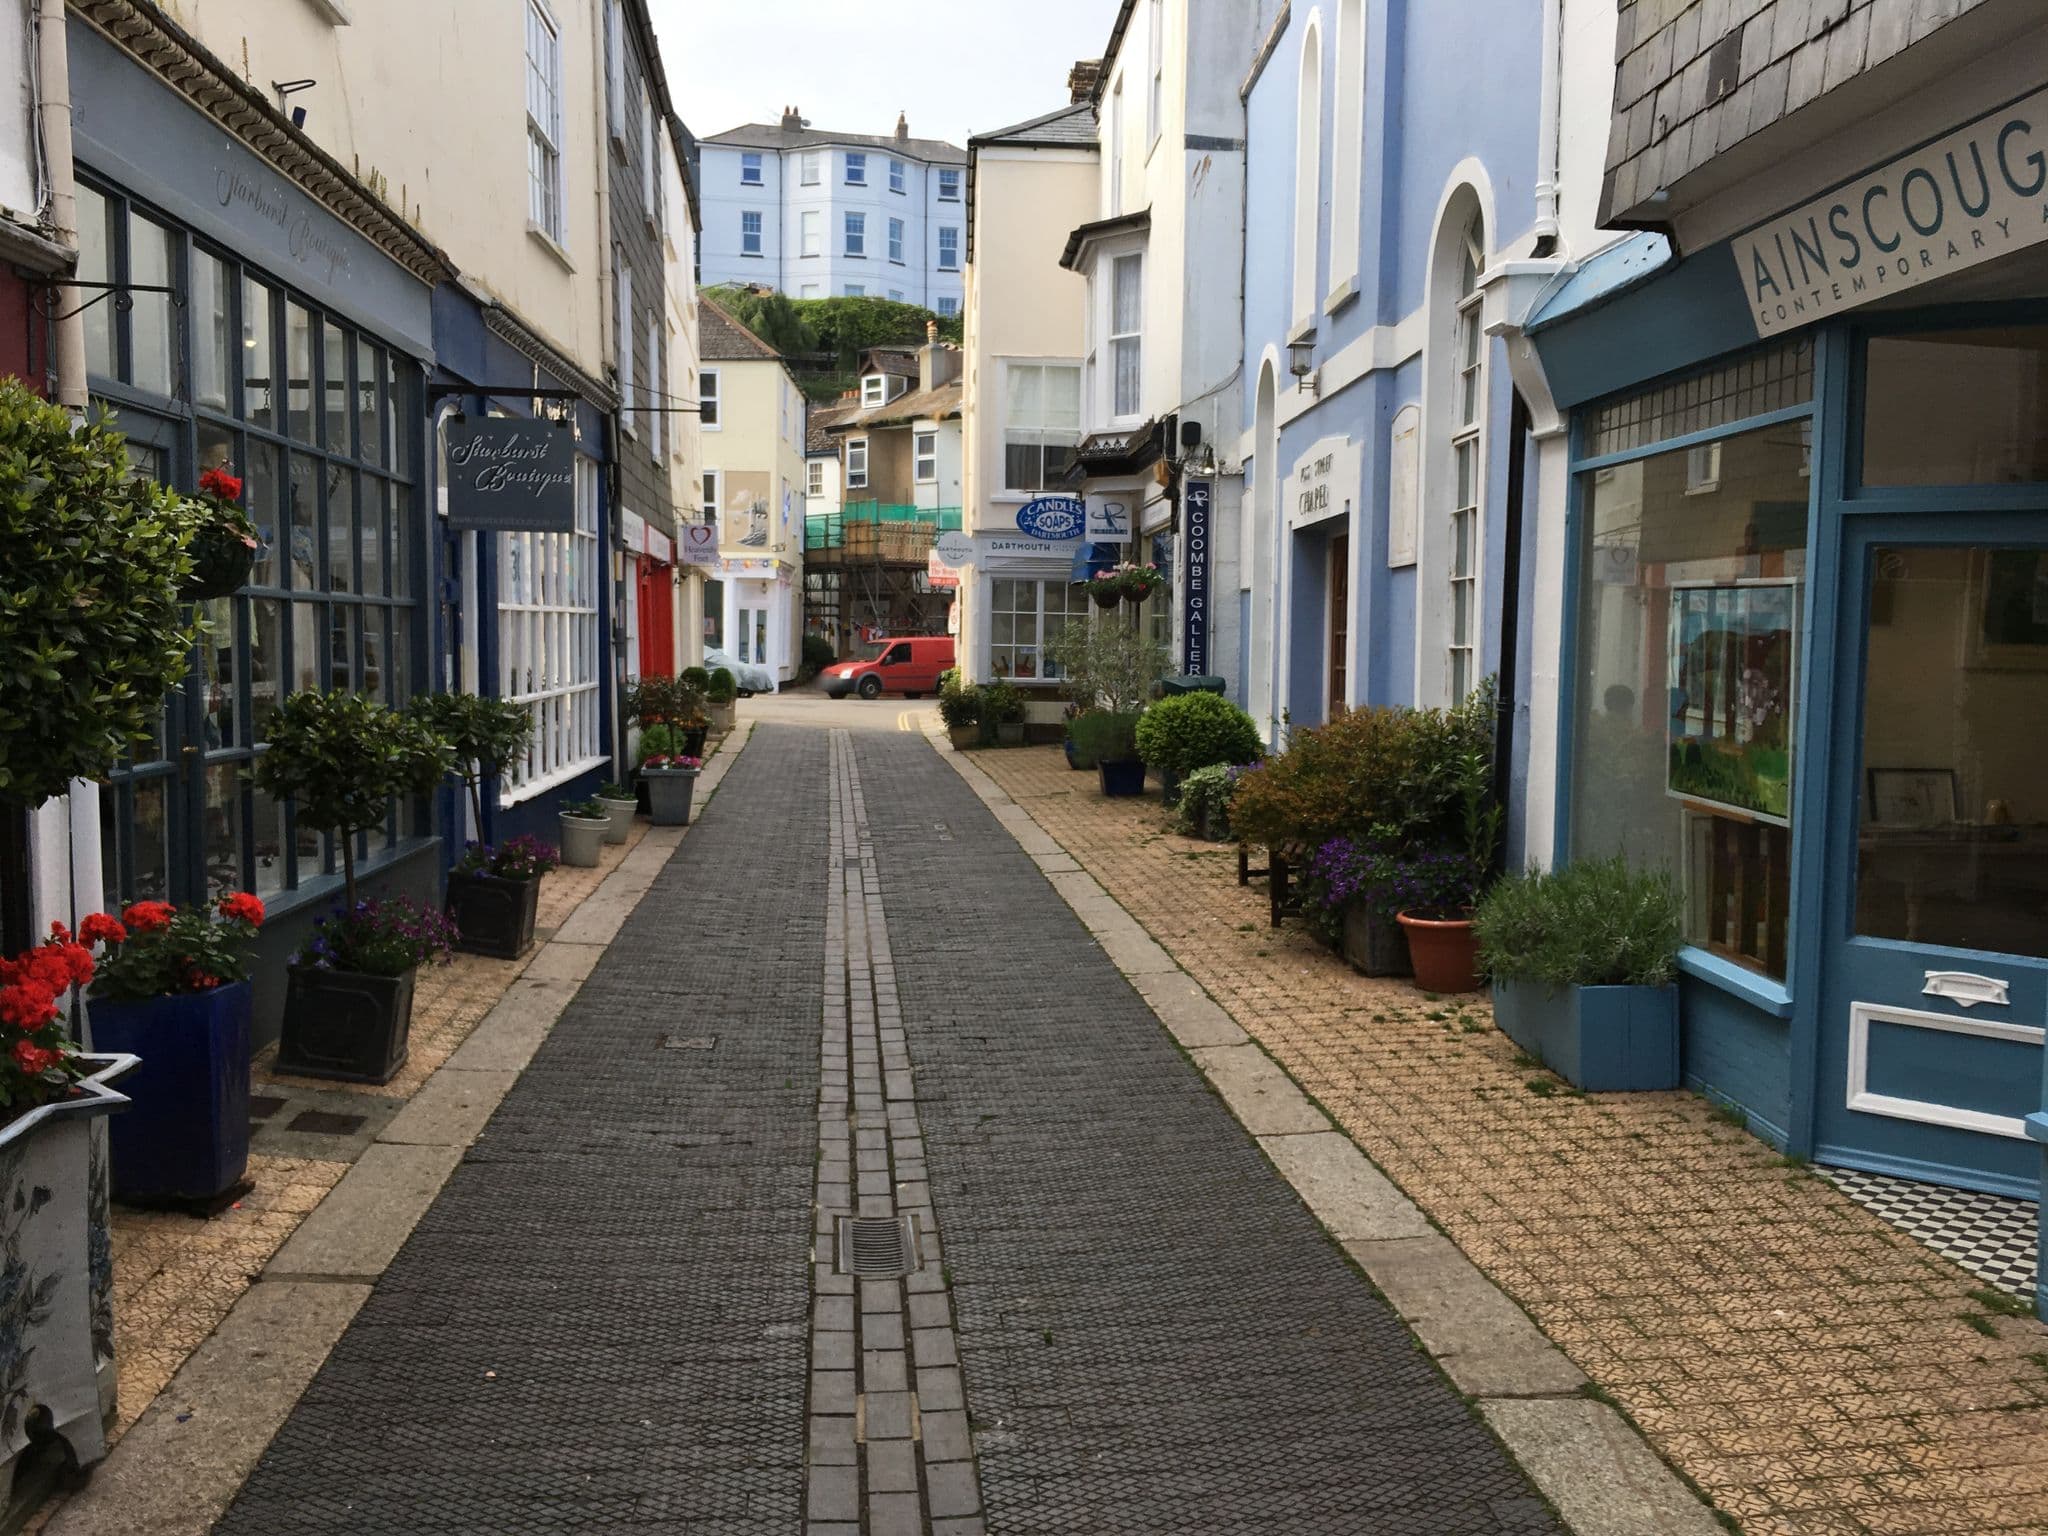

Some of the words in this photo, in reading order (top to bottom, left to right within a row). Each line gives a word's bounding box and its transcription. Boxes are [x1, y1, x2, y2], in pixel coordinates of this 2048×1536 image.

[1752, 119, 2048, 304] AINSCOUG
[1760, 217, 2010, 326] CONTEMPORARY
[451, 433, 549, 465] Starburst
[475, 461, 573, 497] Boutique
[1026, 499, 1083, 516] CANDLES
[1299, 484, 1329, 516] CHAPEL
[1039, 515, 1072, 529] SOAPS
[991, 541, 1051, 552] DARTMOUTH
[1190, 512, 1205, 590] COOMBE
[1188, 597, 1204, 677] GALLER
